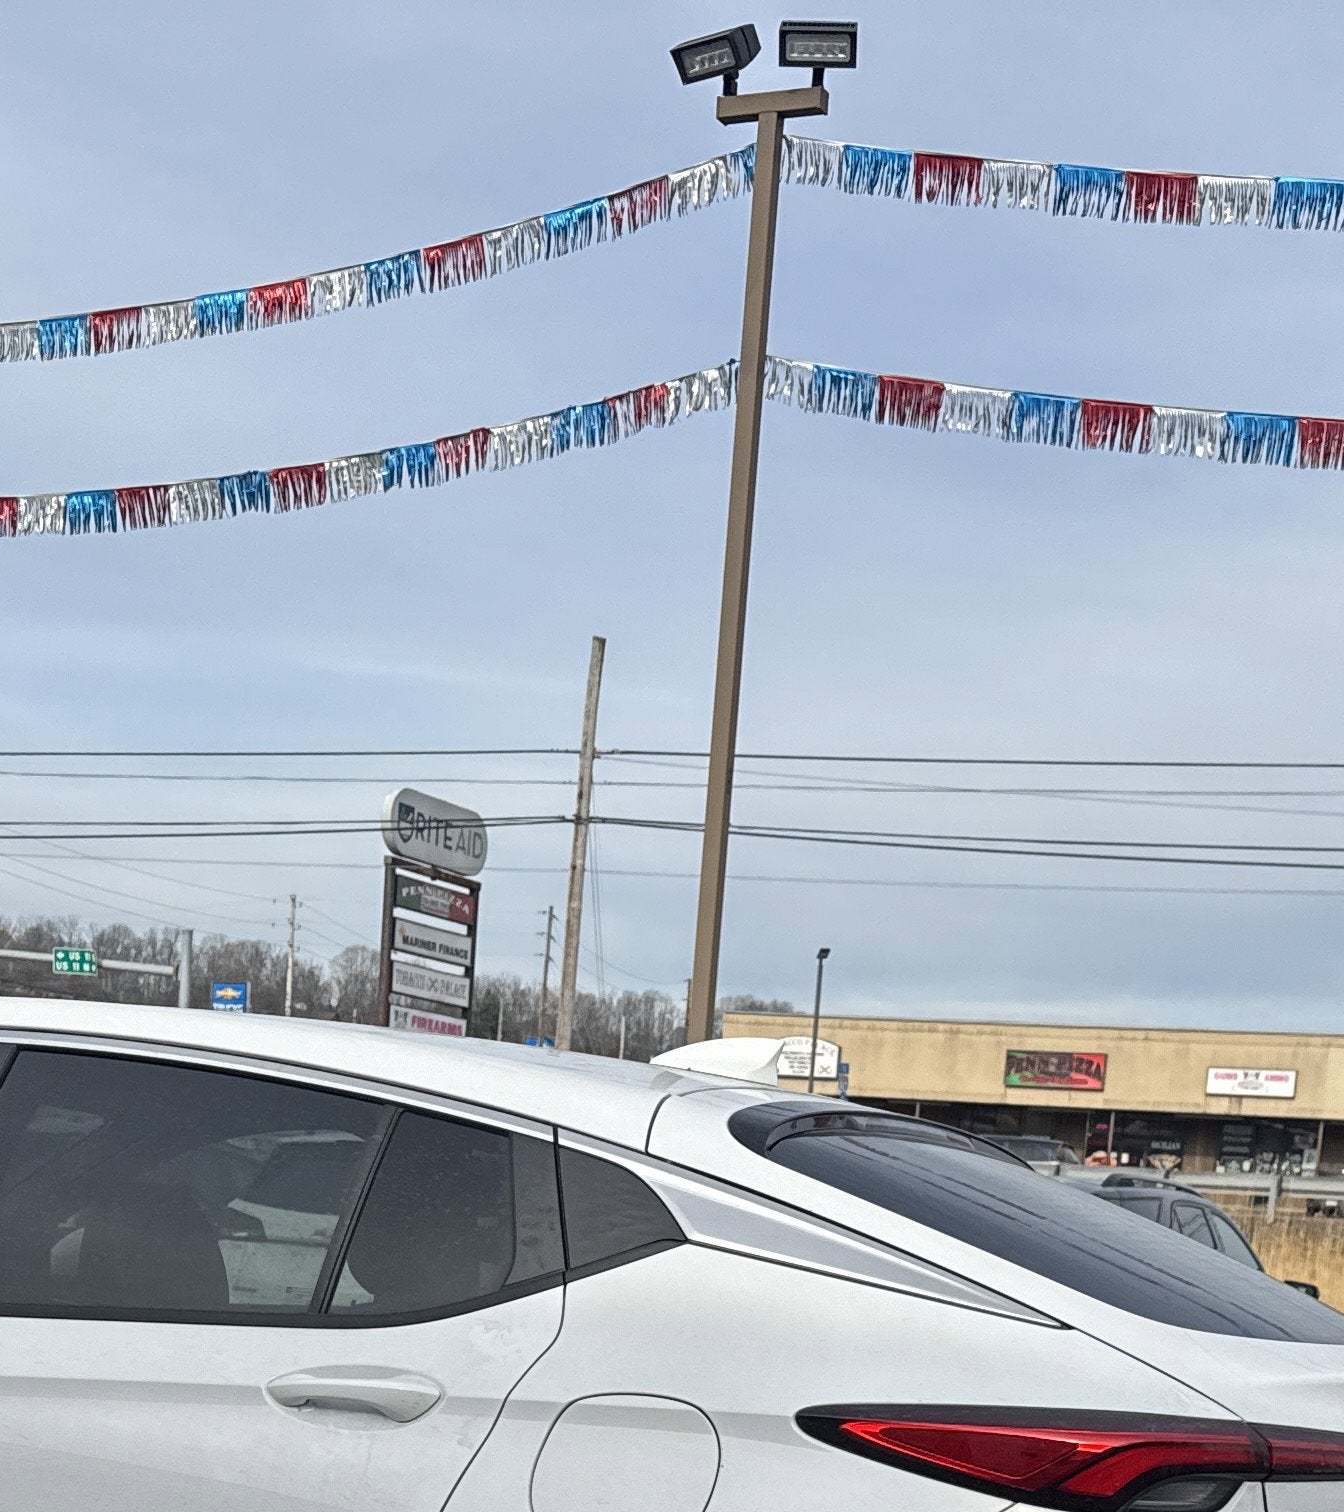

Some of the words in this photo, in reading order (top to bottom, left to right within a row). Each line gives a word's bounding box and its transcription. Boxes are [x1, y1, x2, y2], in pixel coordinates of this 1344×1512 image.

[416, 811, 453, 850] RITE
[456, 826, 484, 859] AID
[402, 934, 437, 953] MARINER
[438, 943, 469, 961] FINANCE
